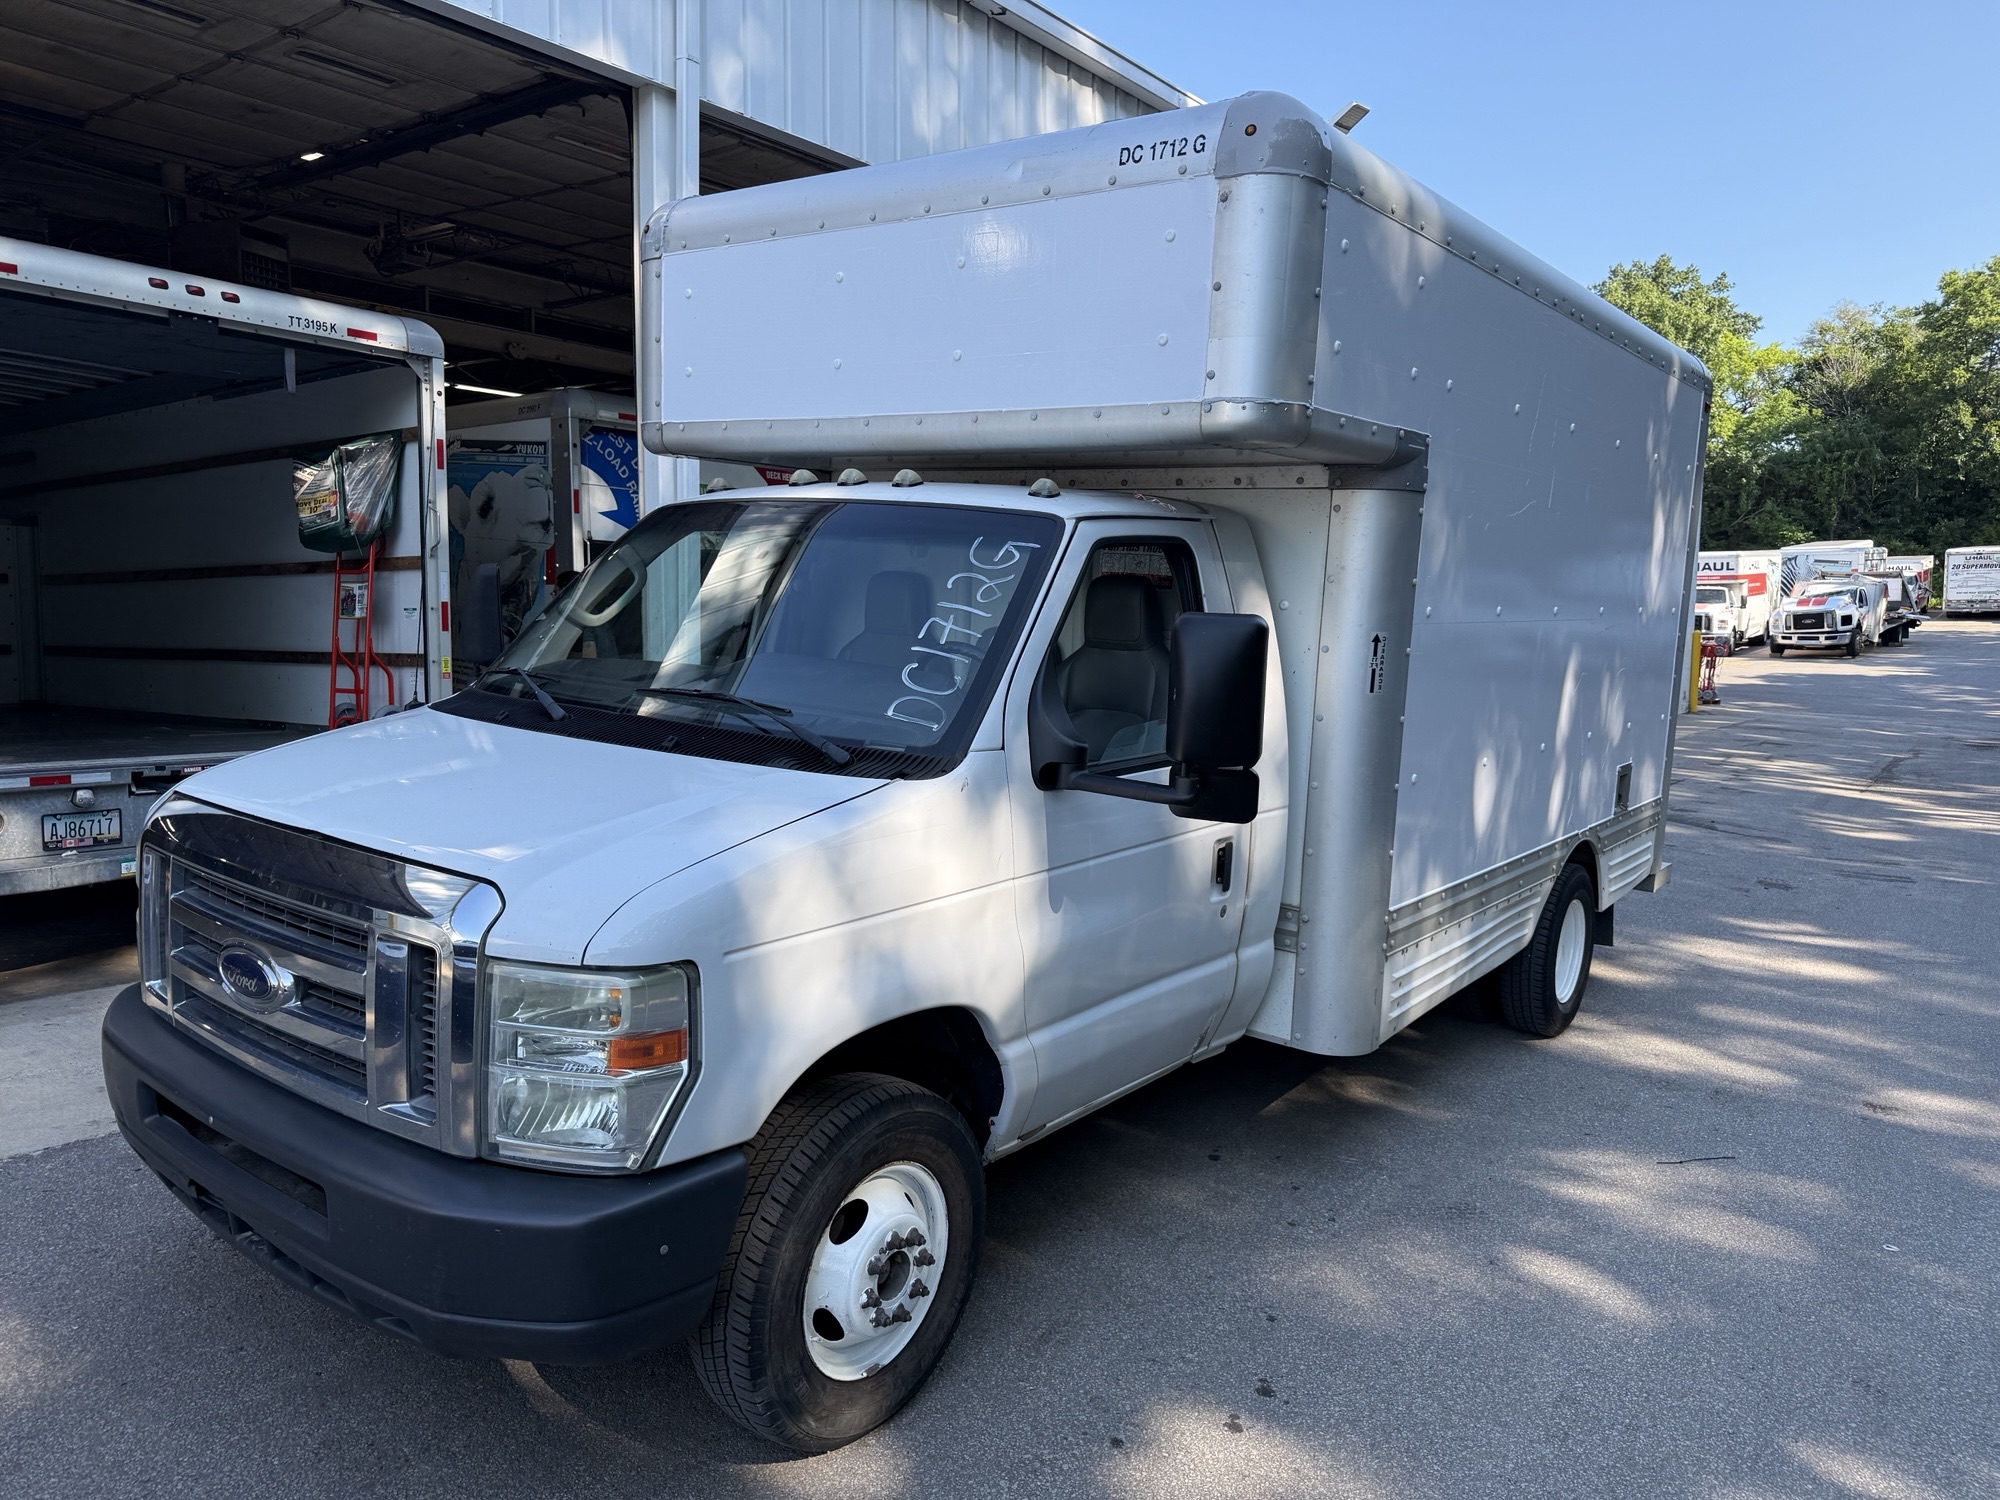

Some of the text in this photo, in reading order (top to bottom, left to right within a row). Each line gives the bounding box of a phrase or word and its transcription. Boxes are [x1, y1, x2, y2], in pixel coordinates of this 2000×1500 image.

[1119, 134, 1206, 166] DC 1712 G
[516, 444, 545, 454] YUKON
[608, 432, 633, 455] EST
[585, 430, 639, 522] Z-LOAD RAM
[766, 470, 781, 480] DECK
[50, 817, 113, 841] AJ86717
[223, 961, 258, 992] Ford
